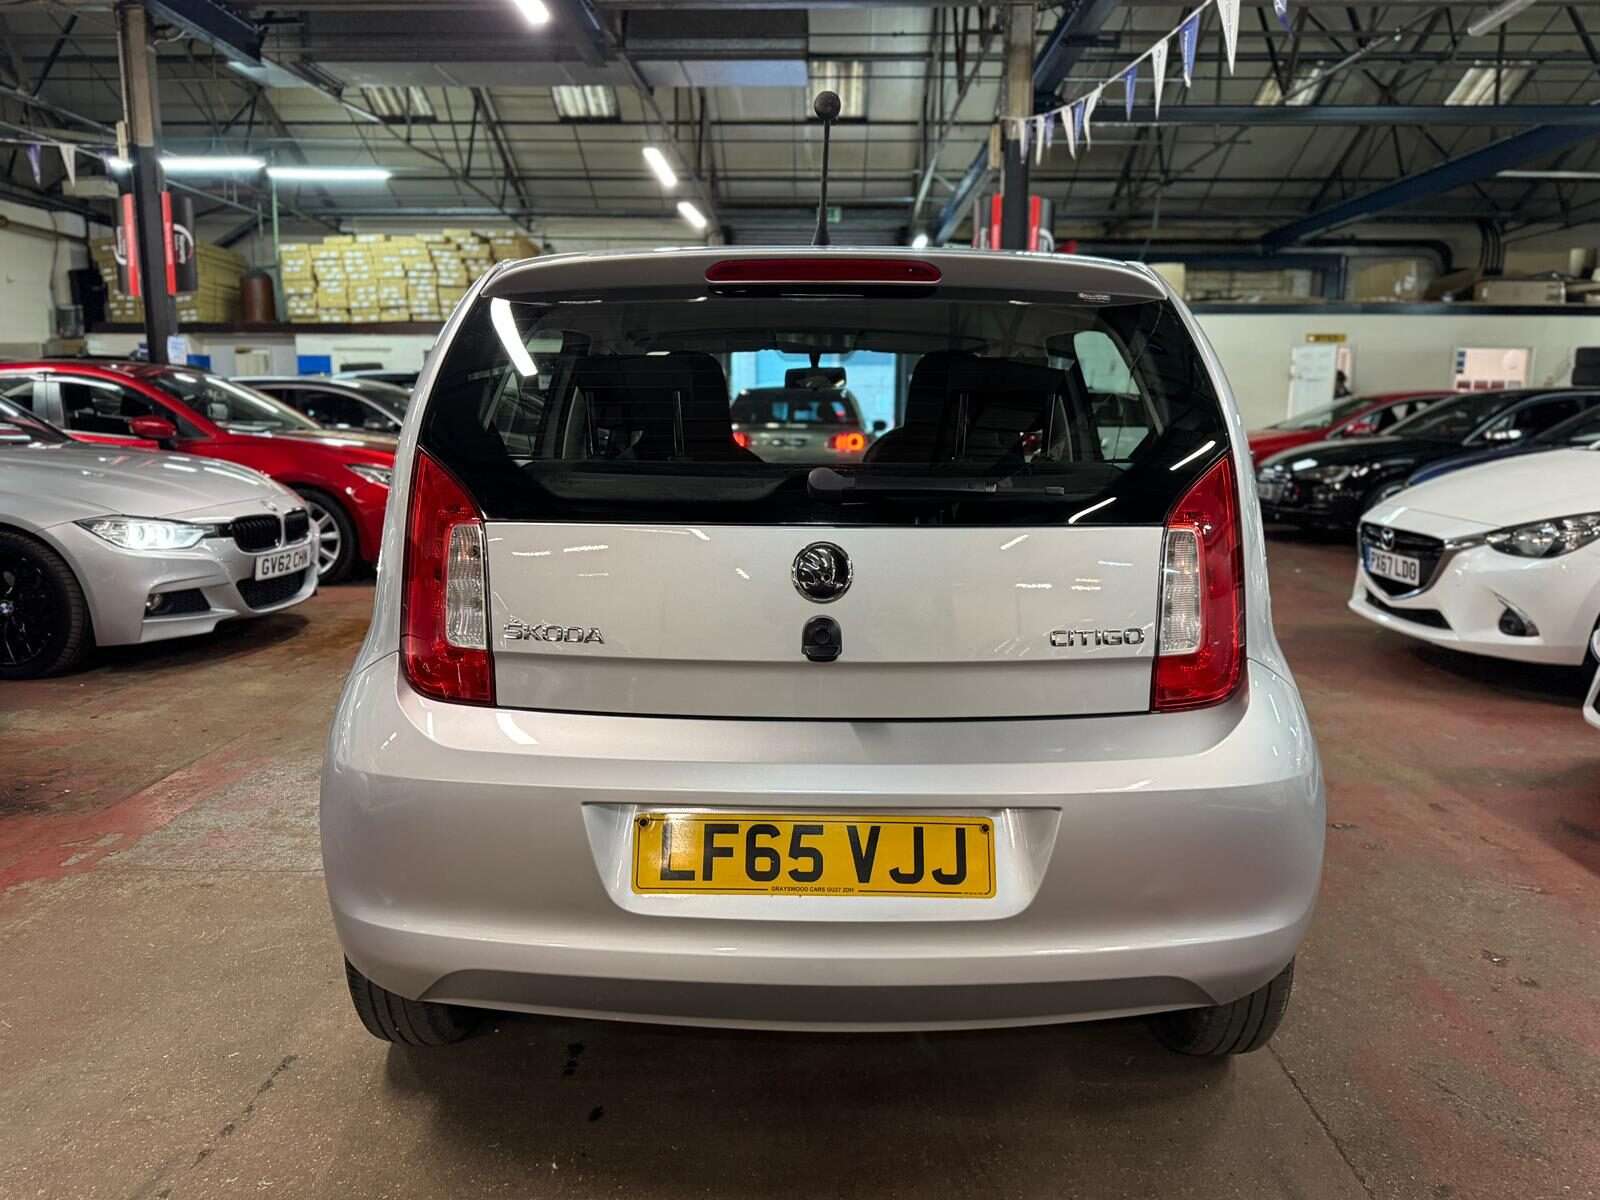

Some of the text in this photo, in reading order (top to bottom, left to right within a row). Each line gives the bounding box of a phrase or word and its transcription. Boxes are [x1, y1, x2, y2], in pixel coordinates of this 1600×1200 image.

[262, 553, 291, 576] GV62
[1370, 551, 1392, 575] PX67
[503, 615, 605, 644] ŠKODA
[1049, 628, 1145, 647] CITIGO
[660, 823, 967, 885] LF65 VJJ
